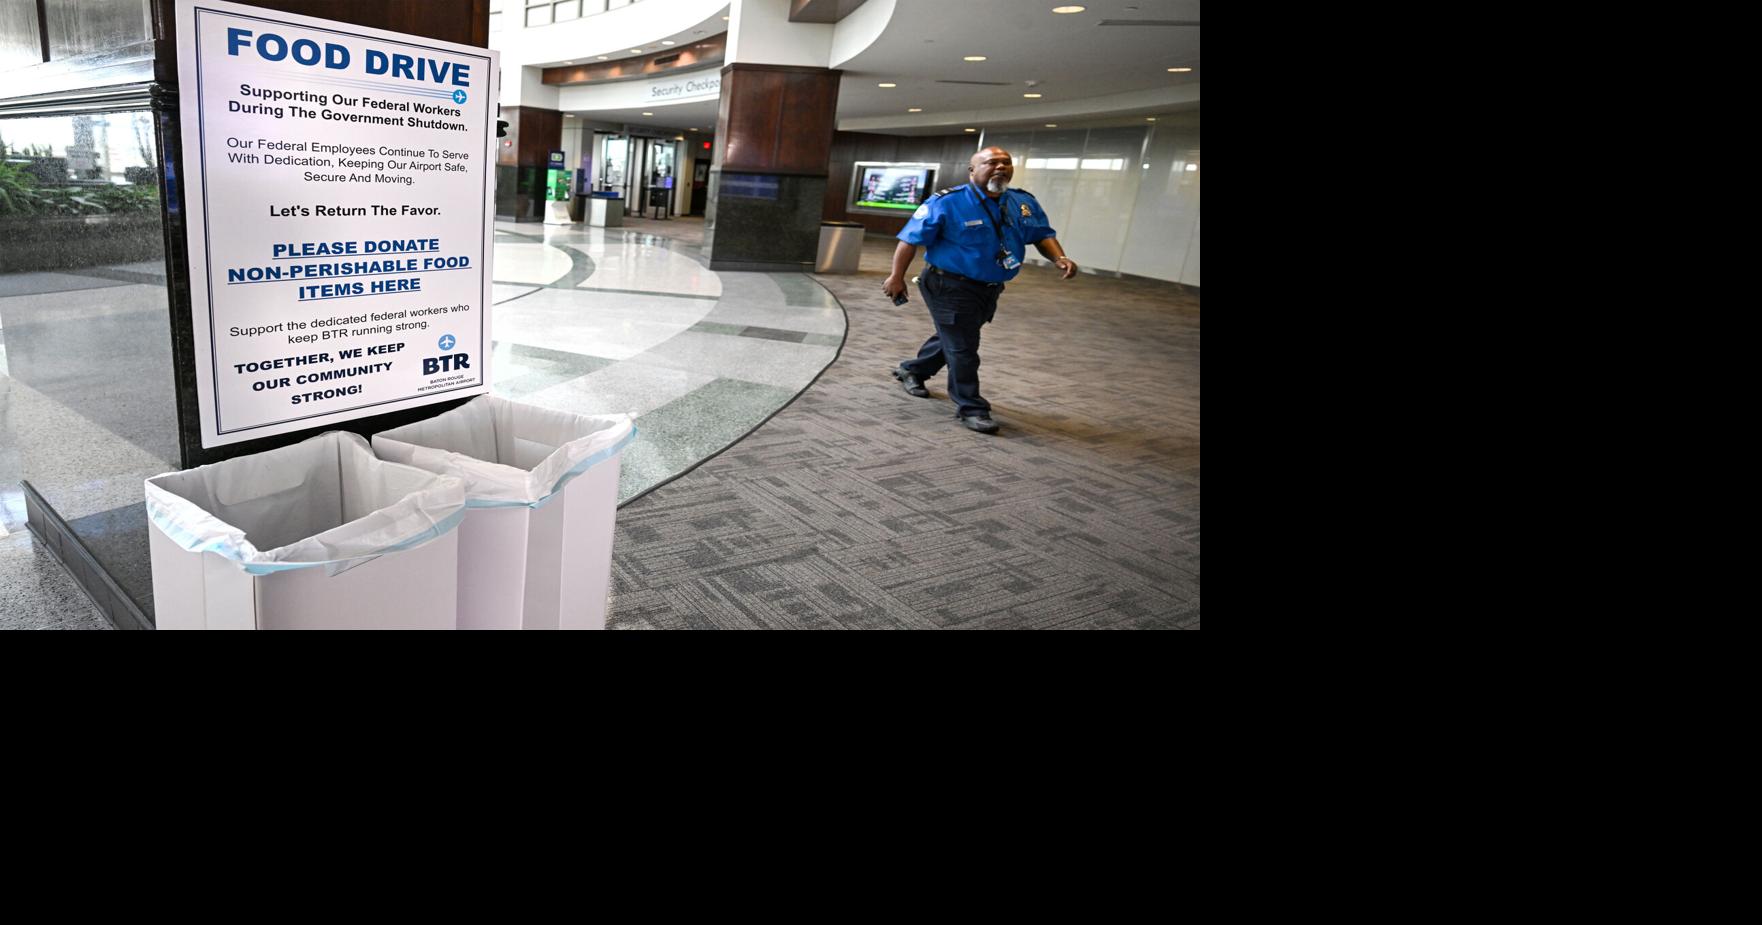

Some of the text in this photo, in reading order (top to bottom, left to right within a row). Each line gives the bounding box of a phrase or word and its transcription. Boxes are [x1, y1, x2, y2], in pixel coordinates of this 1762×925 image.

[227, 27, 470, 87] FOOD DRIVE
[240, 84, 461, 117] Supporting Our Federal Workers
[652, 83, 683, 97] Security
[229, 100, 467, 131] During The Government Shutdown.
[227, 137, 469, 160] Our Federal Employees Continue To Serve
[228, 152, 467, 173] With Dedication, Keeping Our Airport Safe,
[304, 171, 415, 186] Secure And Moving.
[270, 205, 440, 217] Let's Return The Favor.
[273, 239, 440, 257] PLEASE DONATE
[228, 256, 470, 282] NON-PERISHABLE FOOD
[298, 278, 421, 299] ITEMS HERE
[230, 304, 469, 337] Support the dedicated federal workers who
[288, 321, 429, 344] keep BTR running strong.
[234, 343, 405, 375] TOGETHER, WE KEEP
[423, 353, 470, 376] BTR
[252, 361, 392, 391] OUR COMMUNITY
[417, 382, 454, 392] METROPOLITAN
[291, 385, 362, 405] STRONG!
